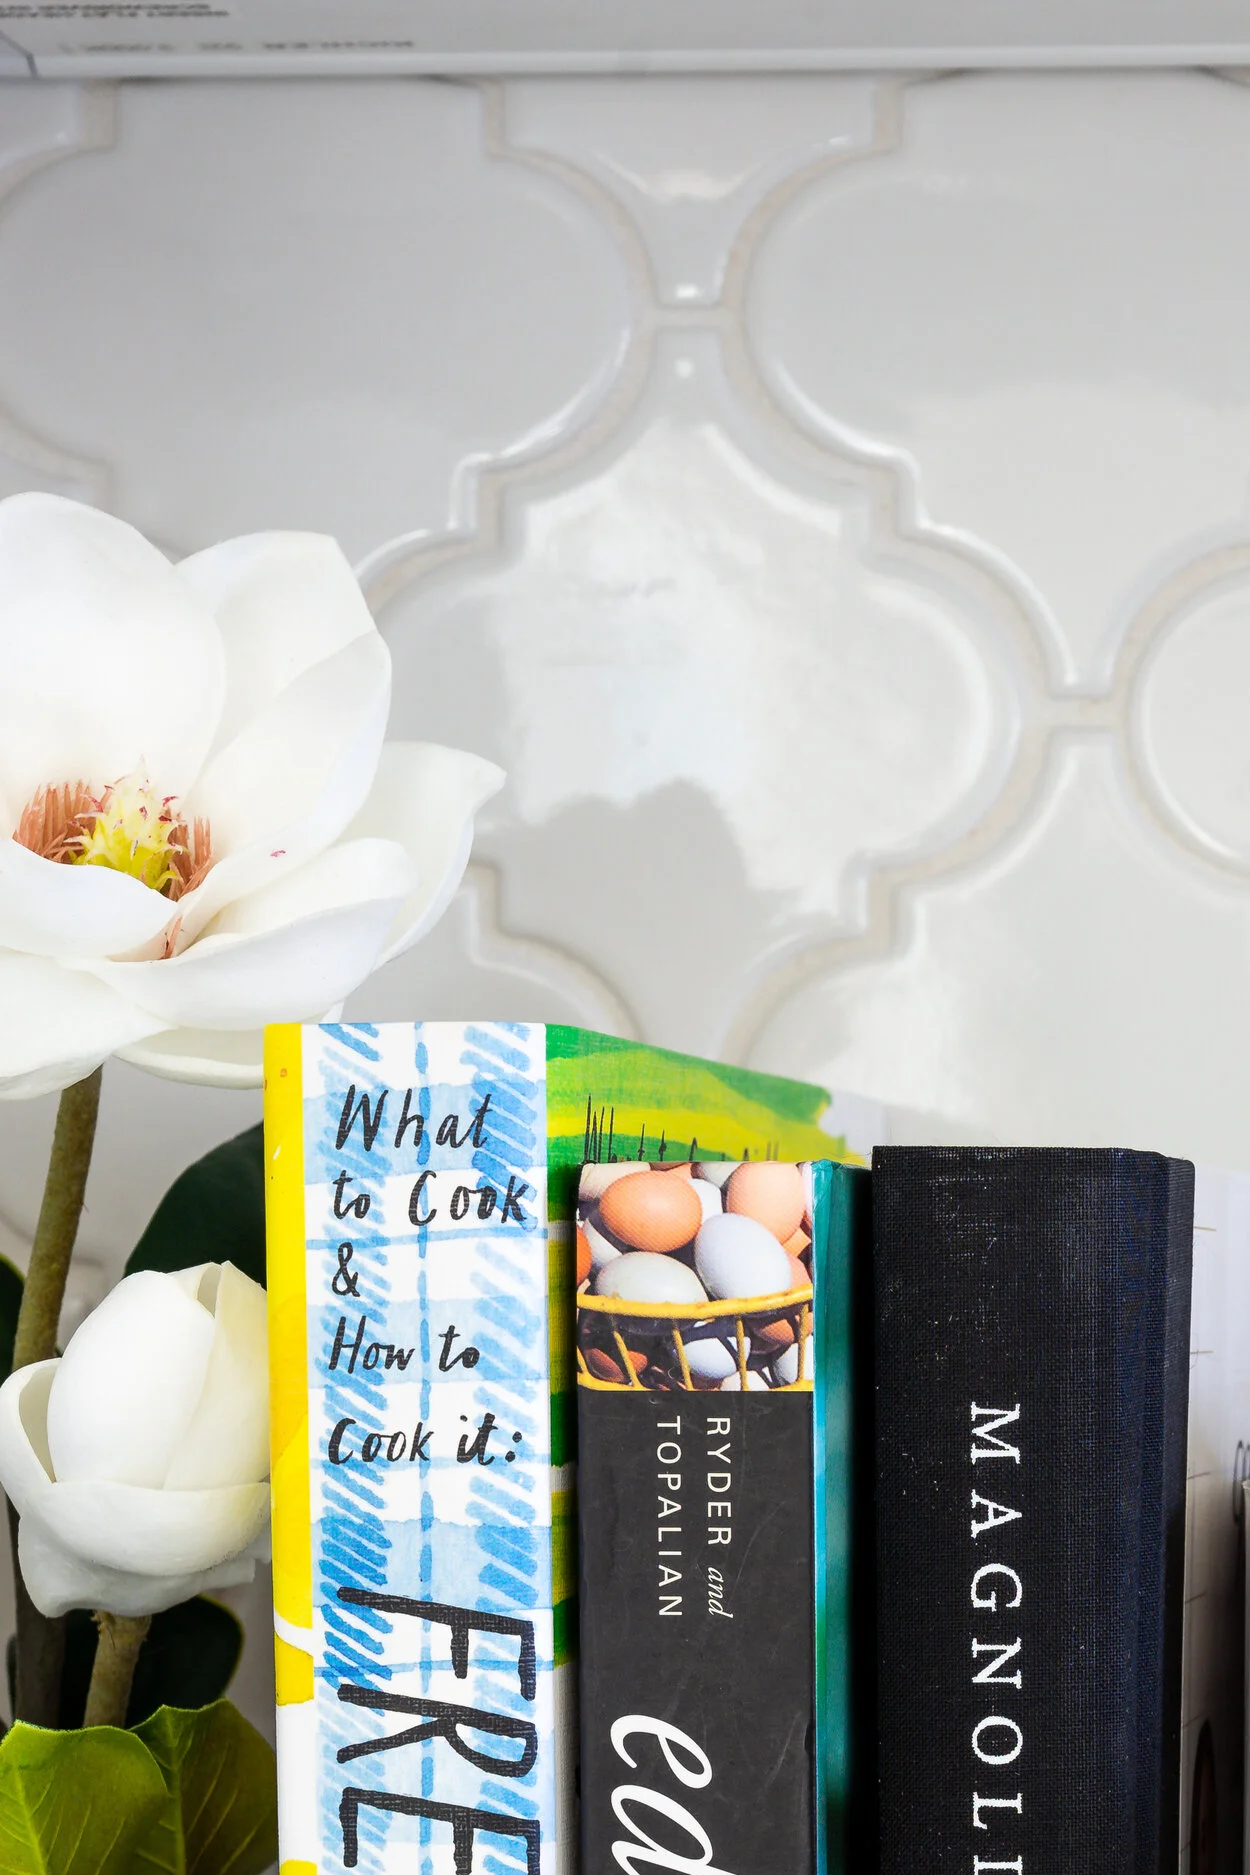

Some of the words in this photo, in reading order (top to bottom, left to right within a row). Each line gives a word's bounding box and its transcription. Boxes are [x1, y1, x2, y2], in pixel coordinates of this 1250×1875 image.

[334, 1084, 491, 1151] What
[332, 1169, 369, 1218] to
[408, 1169, 527, 1224] Cook
[331, 1242, 360, 1296] &
[328, 1316, 414, 1370] How
[437, 1323, 479, 1369] to
[327, 1417, 432, 1464] Cook
[457, 1413, 521, 1463] it:
[704, 1416, 732, 1545] RYDER
[655, 1415, 682, 1617] TOPALIAN
[706, 1566, 733, 1617] and
